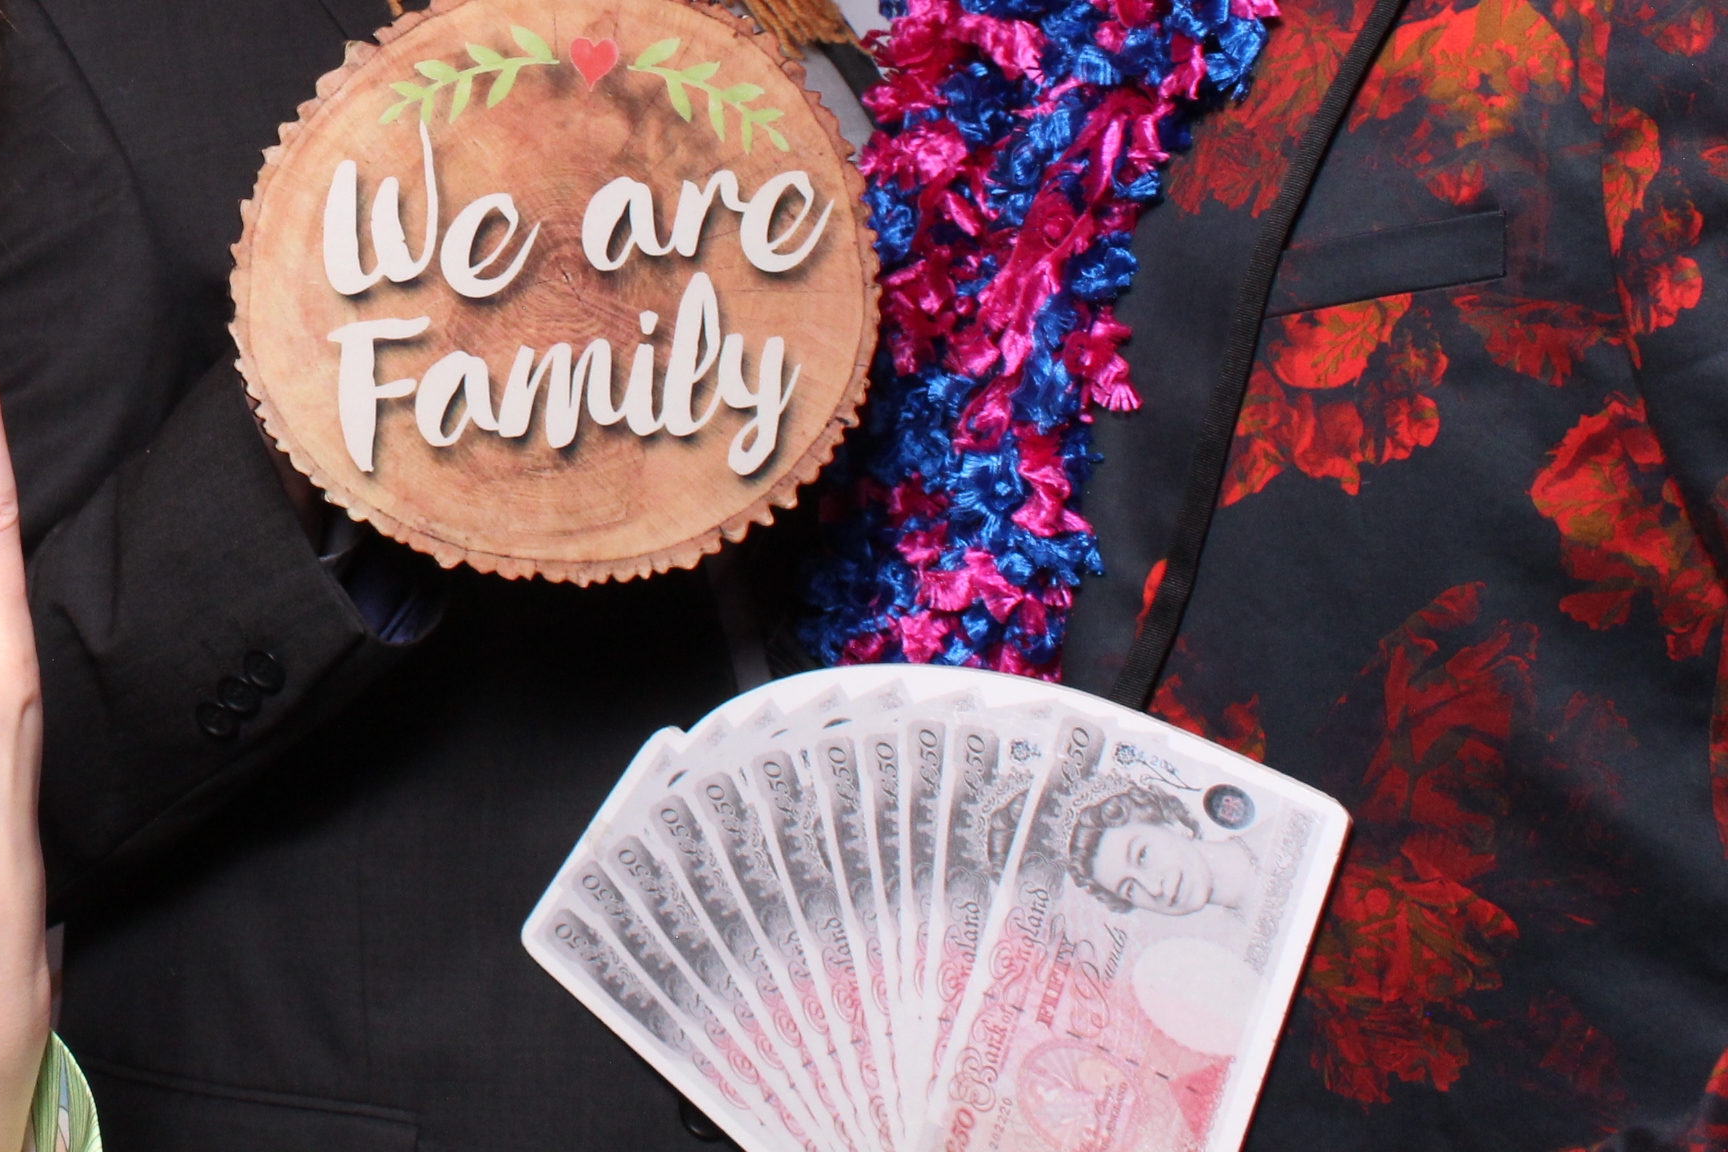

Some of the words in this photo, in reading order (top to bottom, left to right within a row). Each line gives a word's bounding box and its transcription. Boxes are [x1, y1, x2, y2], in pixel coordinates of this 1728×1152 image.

[323, 120, 539, 298] We
[582, 169, 834, 273] are
[328, 272, 801, 476] Family
[762, 760, 797, 816] £50
[828, 746, 860, 812] £50
[876, 741, 899, 803] £50
[918, 728, 940, 795] £50
[964, 733, 986, 799] £50
[1060, 726, 1090, 786] £50
[660, 807, 701, 855] £50
[705, 783, 743, 833] £50
[581, 873, 623, 916] £50
[618, 848, 661, 893] £50
[554, 922, 606, 963] £50
[989, 883, 1050, 996] England
[1036, 932, 1076, 1029] FIFTY
[1070, 923, 1128, 1038] Pounds
[1001, 1004, 1017, 1034] of
[948, 1011, 1008, 1112] Bank
